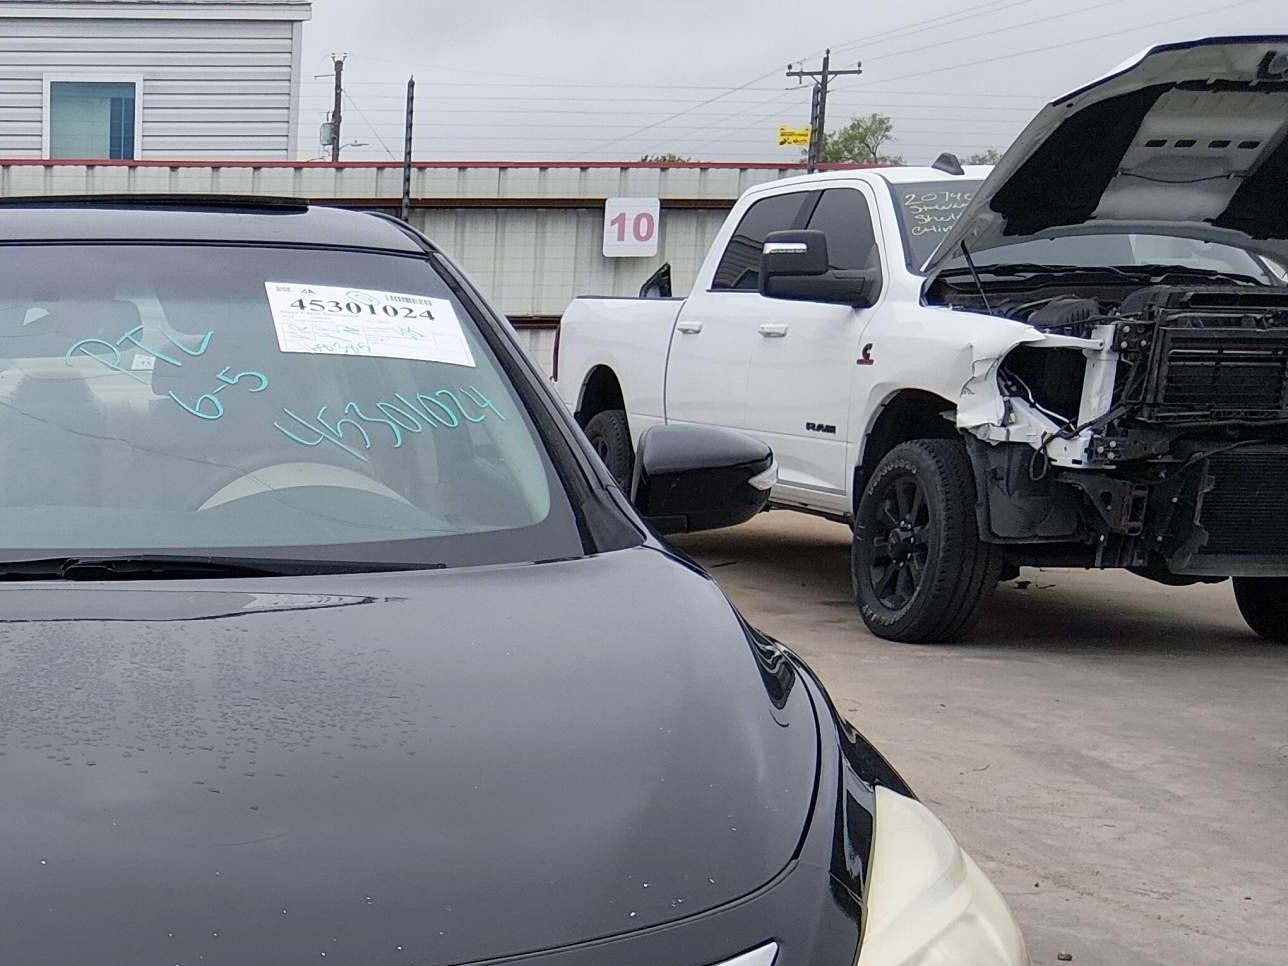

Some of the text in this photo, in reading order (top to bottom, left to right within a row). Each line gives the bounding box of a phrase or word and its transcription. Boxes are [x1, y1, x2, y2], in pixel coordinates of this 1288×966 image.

[610, 211, 655, 242] 10
[289, 298, 436, 322] 45301024
[273, 384, 506, 463] 45301024
[805, 421, 837, 434] RAM
